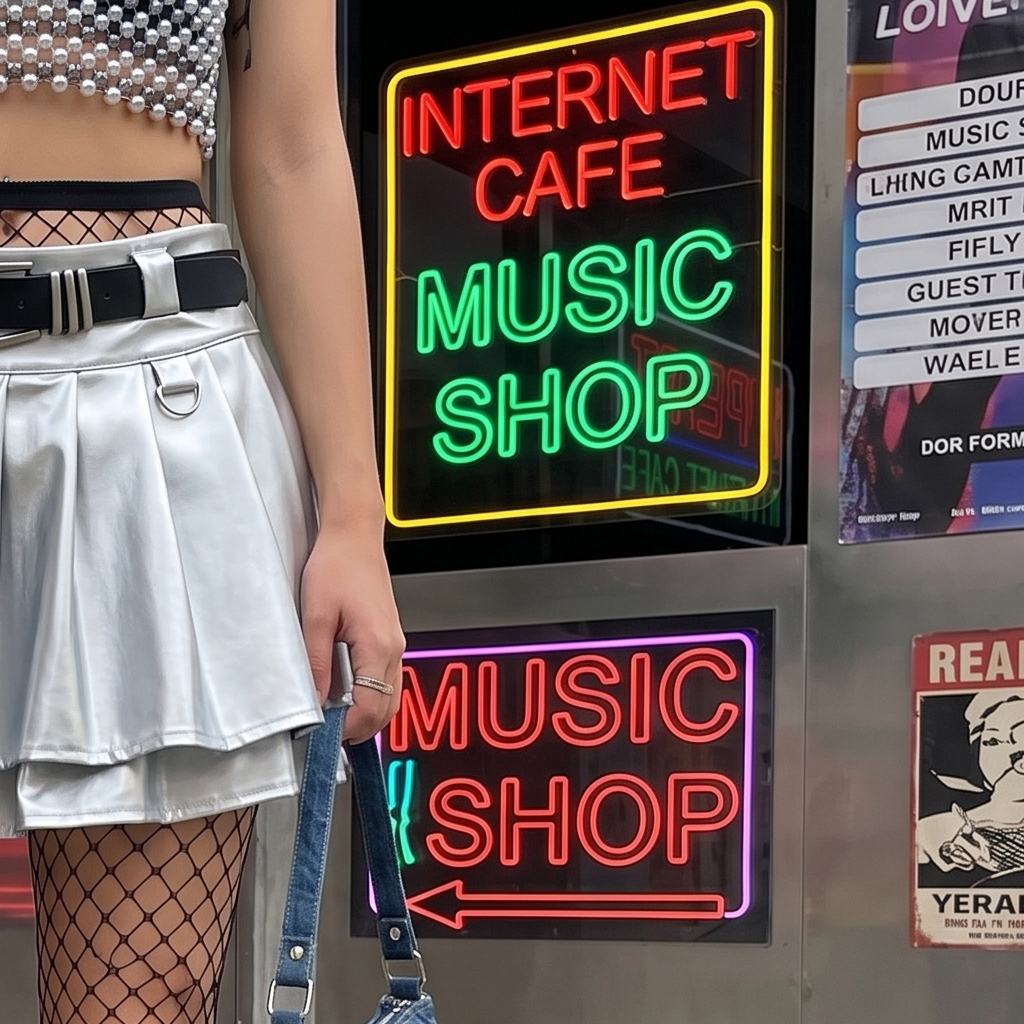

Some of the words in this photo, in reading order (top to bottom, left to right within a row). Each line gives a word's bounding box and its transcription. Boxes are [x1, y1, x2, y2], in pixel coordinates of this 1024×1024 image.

[402, 30, 758, 158] INTERNET
[926, 120, 1009, 151] MUSIC
[475, 132, 666, 222] CAFE
[948, 196, 1013, 223] MRIT
[949, 232, 1022, 261] FIFLY
[416, 229, 734, 354] MUSIC
[907, 273, 997, 303] GUEST
[930, 308, 1022, 338] MOVER
[432, 353, 713, 465] SHOP
[921, 437, 964, 456] DOR
[969, 431, 1024, 452] FORM
[929, 640, 1024, 684] REA
[389, 646, 740, 752] MUSIC
[426, 772, 740, 868] SHOP
[932, 893, 1024, 914] YERA
